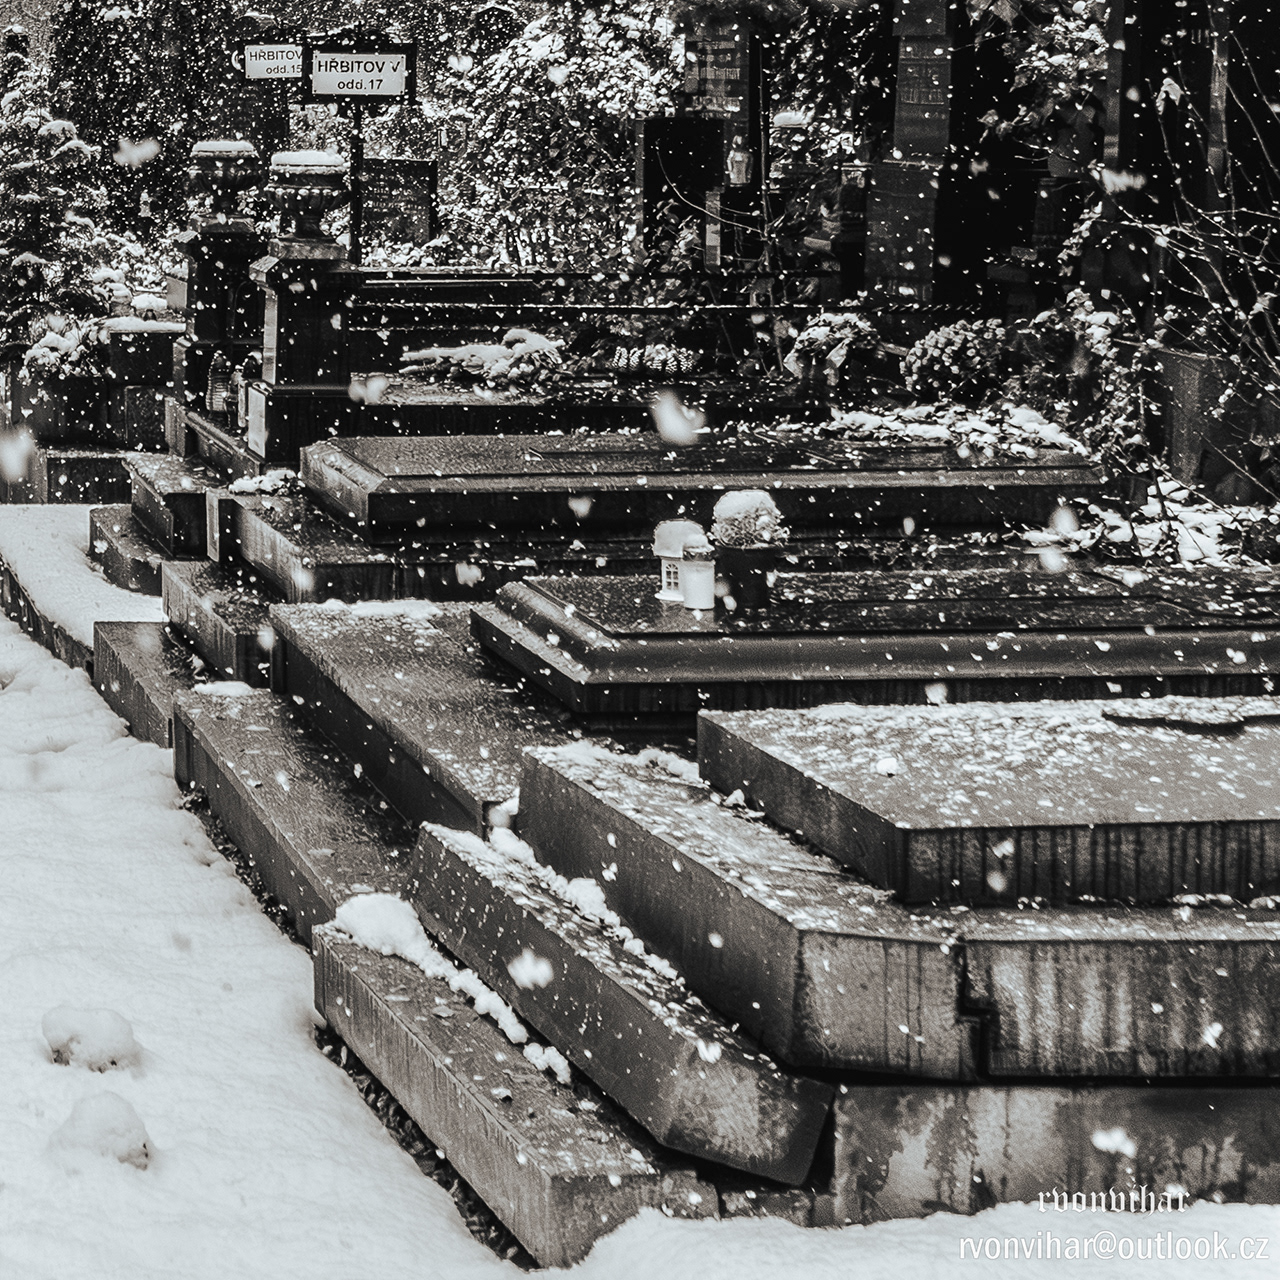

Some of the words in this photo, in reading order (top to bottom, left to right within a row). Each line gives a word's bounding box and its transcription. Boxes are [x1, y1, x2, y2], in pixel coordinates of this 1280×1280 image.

[318, 58, 385, 73] HŘBITOV
[390, 61, 401, 72] V
[337, 79, 383, 90] odd.17
